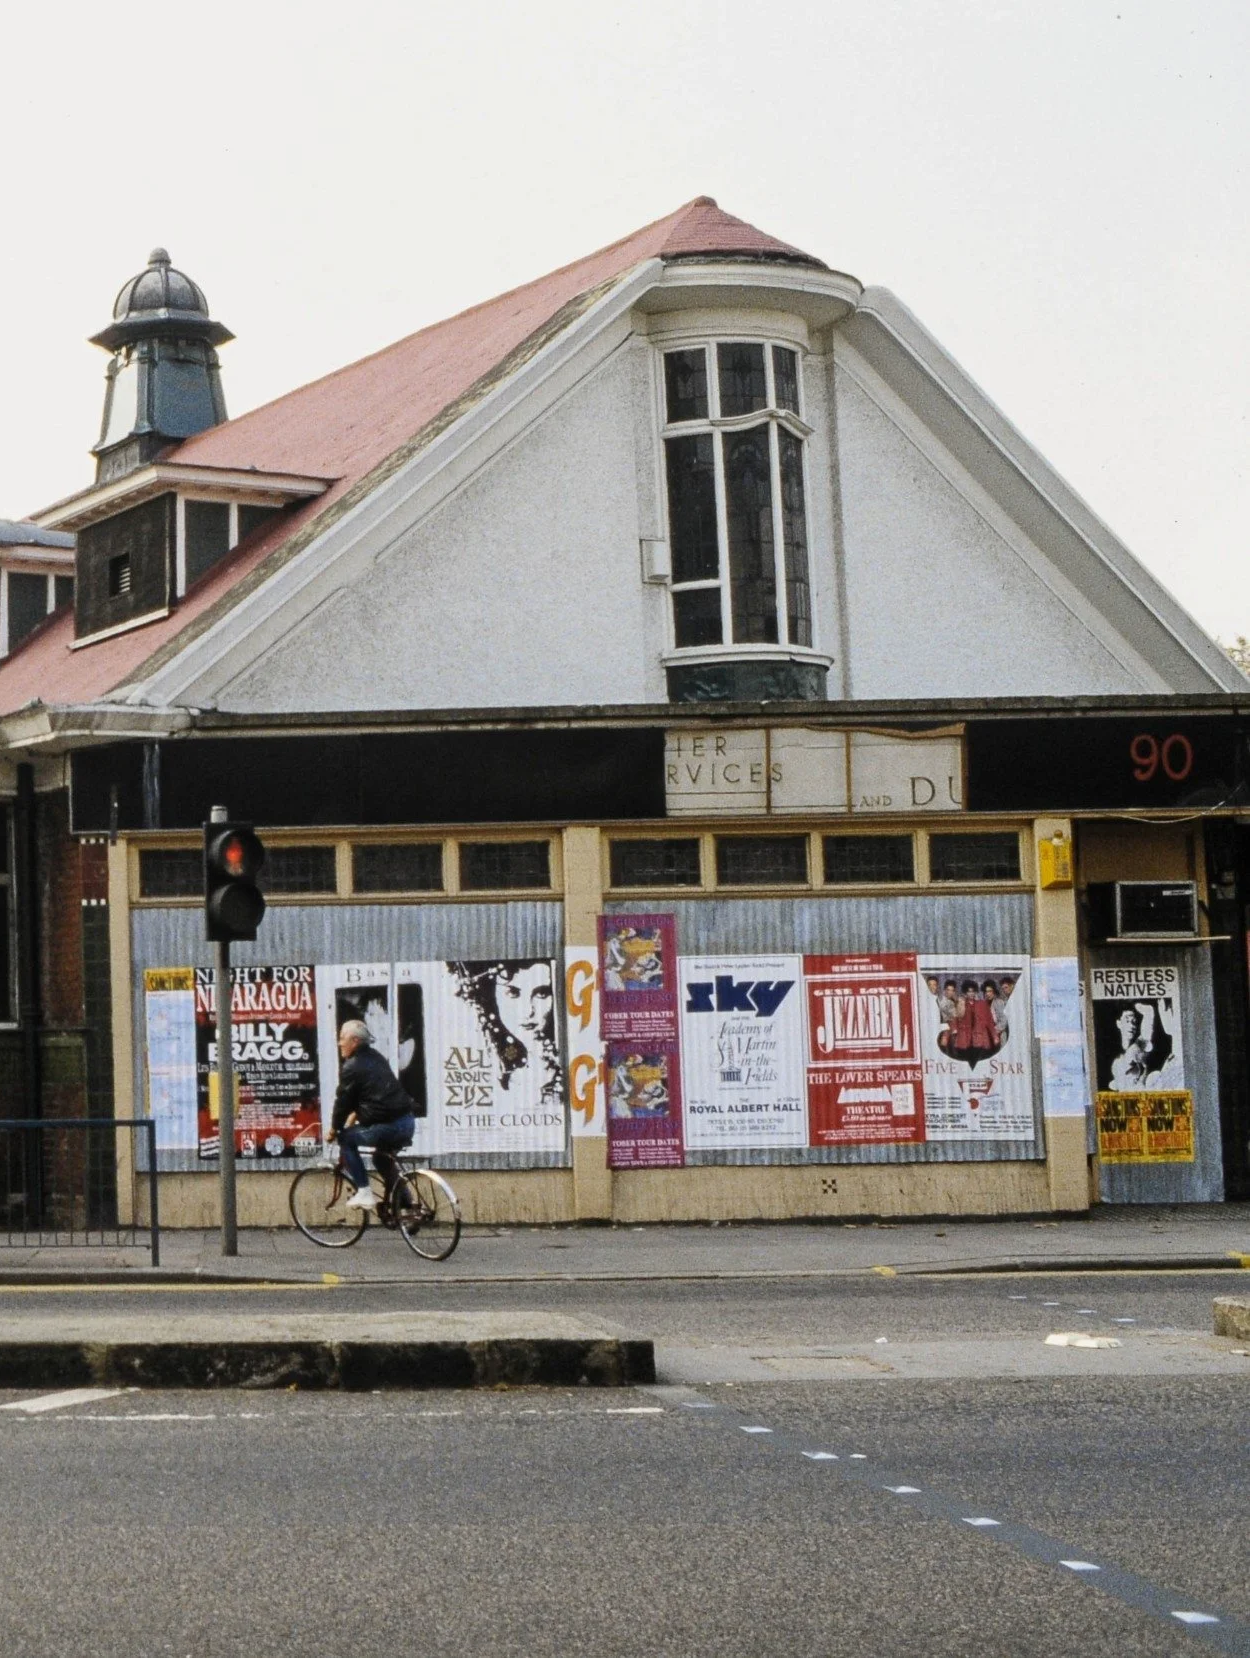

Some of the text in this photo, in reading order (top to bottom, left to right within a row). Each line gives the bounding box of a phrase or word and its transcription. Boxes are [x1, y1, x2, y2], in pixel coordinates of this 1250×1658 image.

[1130, 734, 1193, 780] 90
[667, 763, 783, 785] RVICES
[859, 794, 892, 807] AND
[196, 966, 312, 984] NIHT FOR
[1094, 969, 1175, 984] RESTLESS
[196, 982, 313, 1012] NIARAGUA
[686, 975, 796, 1017] sky
[1104, 983, 1166, 997] NATIVES
[630, 1011, 650, 1019] TOUR
[651, 1010, 674, 1018] DATES
[816, 993, 909, 1054] JEZEBEL
[445, 1046, 492, 1070] ALL
[445, 1070, 492, 1083] ABOUT
[808, 1069, 922, 1085] THE LOVER SPEAKS
[689, 1103, 802, 1114] ROYAL ALBERT HALL
[445, 1113, 563, 1127] IN THE CLOUDS
[1100, 1117, 1127, 1132] NOW
[1147, 1116, 1174, 1131] NOW
